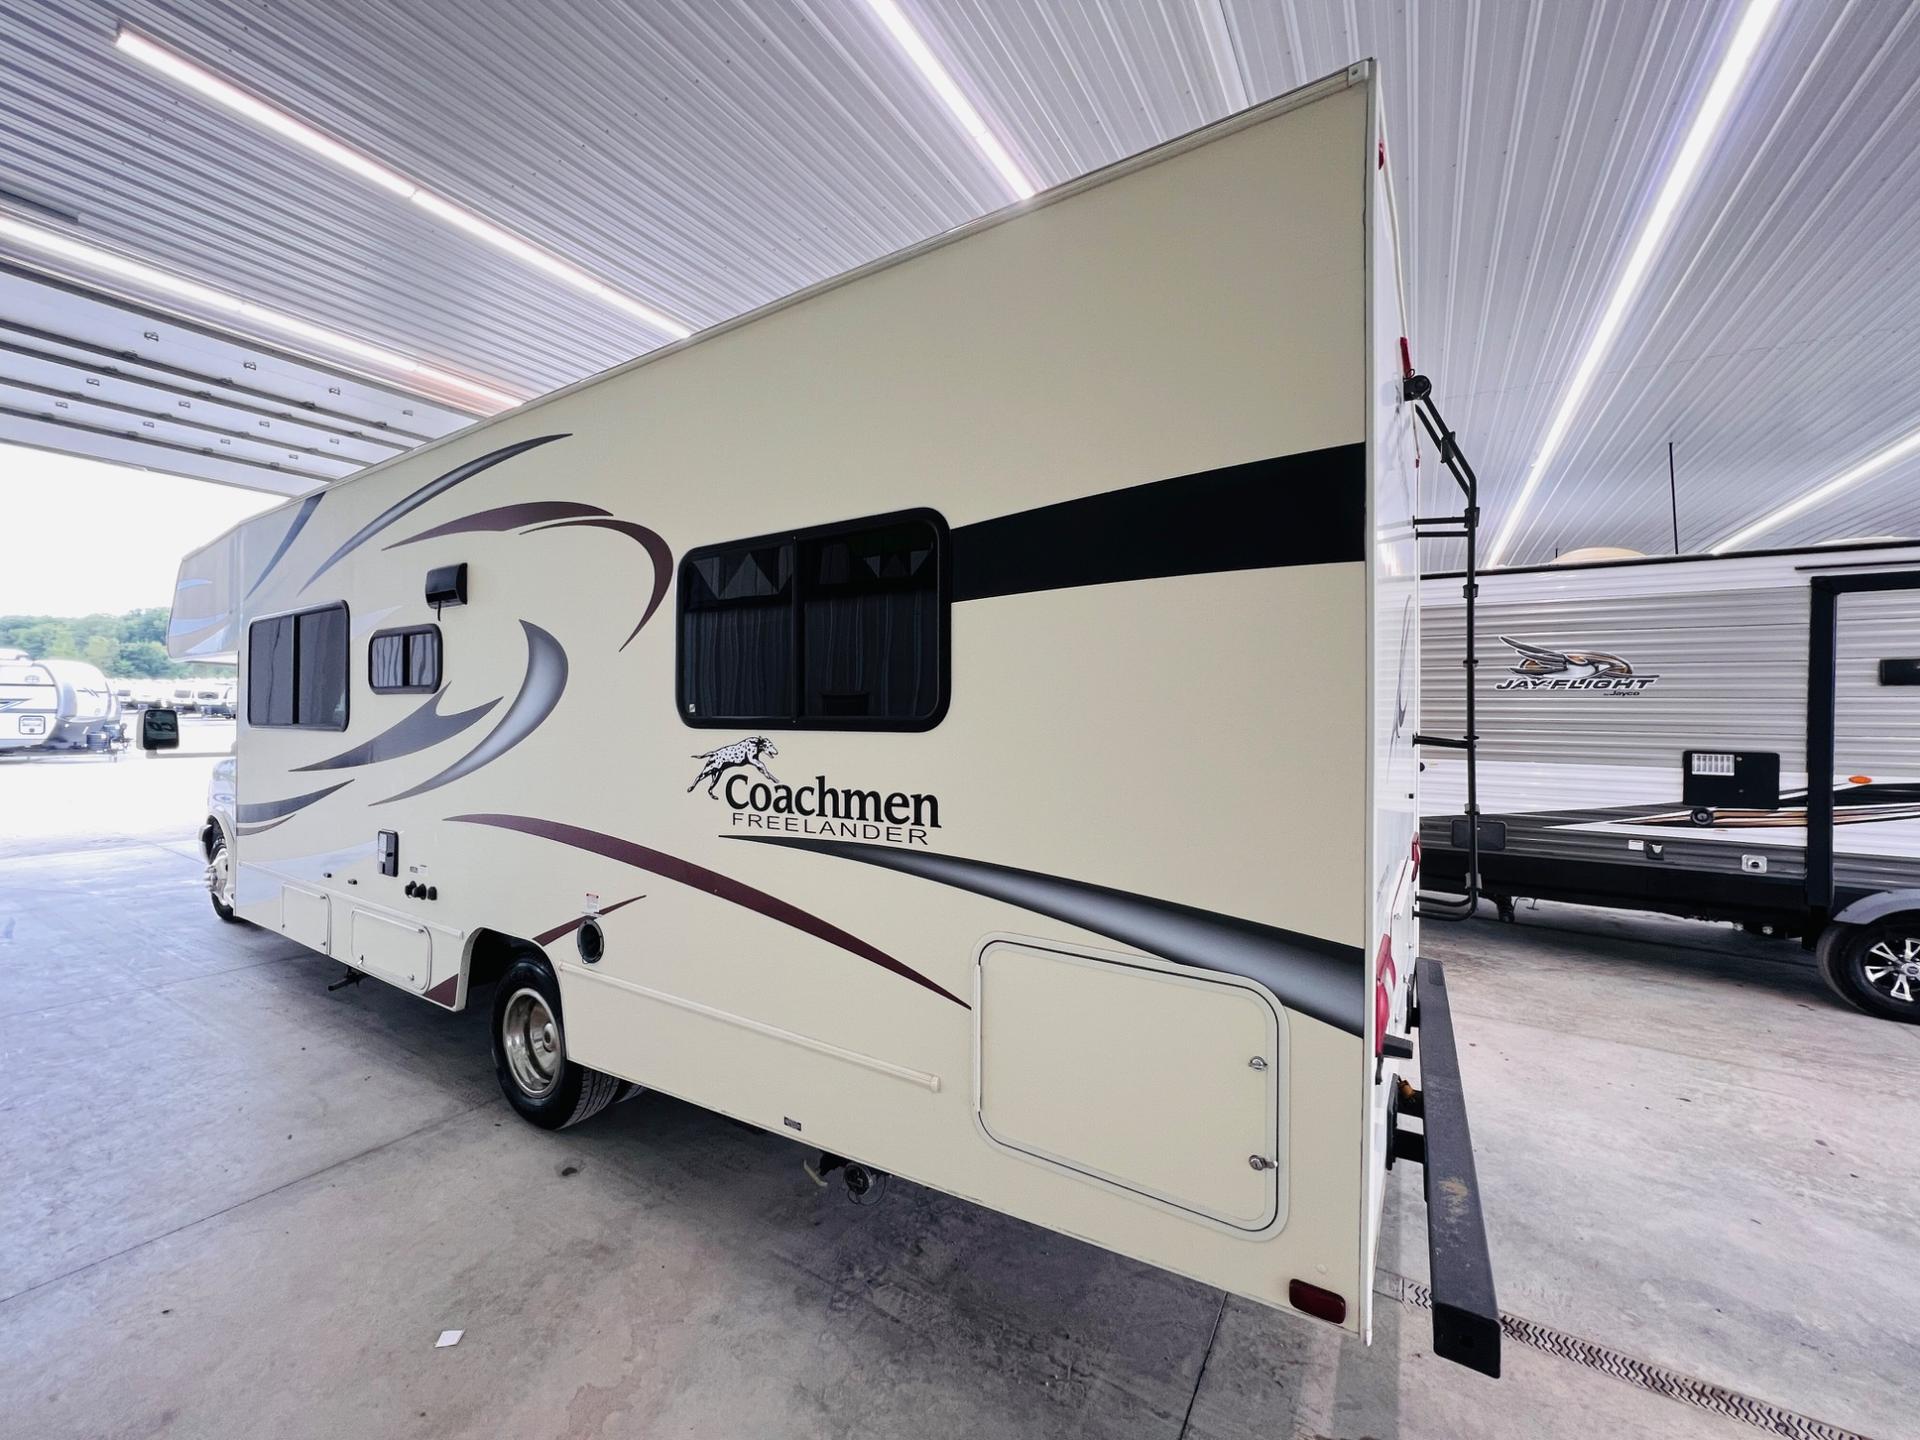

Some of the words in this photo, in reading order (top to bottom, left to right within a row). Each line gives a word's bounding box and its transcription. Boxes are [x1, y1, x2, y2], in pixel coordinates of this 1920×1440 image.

[1496, 679, 1547, 690] JAY
[1550, 679, 1655, 690] FLIGHT
[725, 774, 942, 829] Coachmen
[732, 812, 928, 845] FREELANDER
